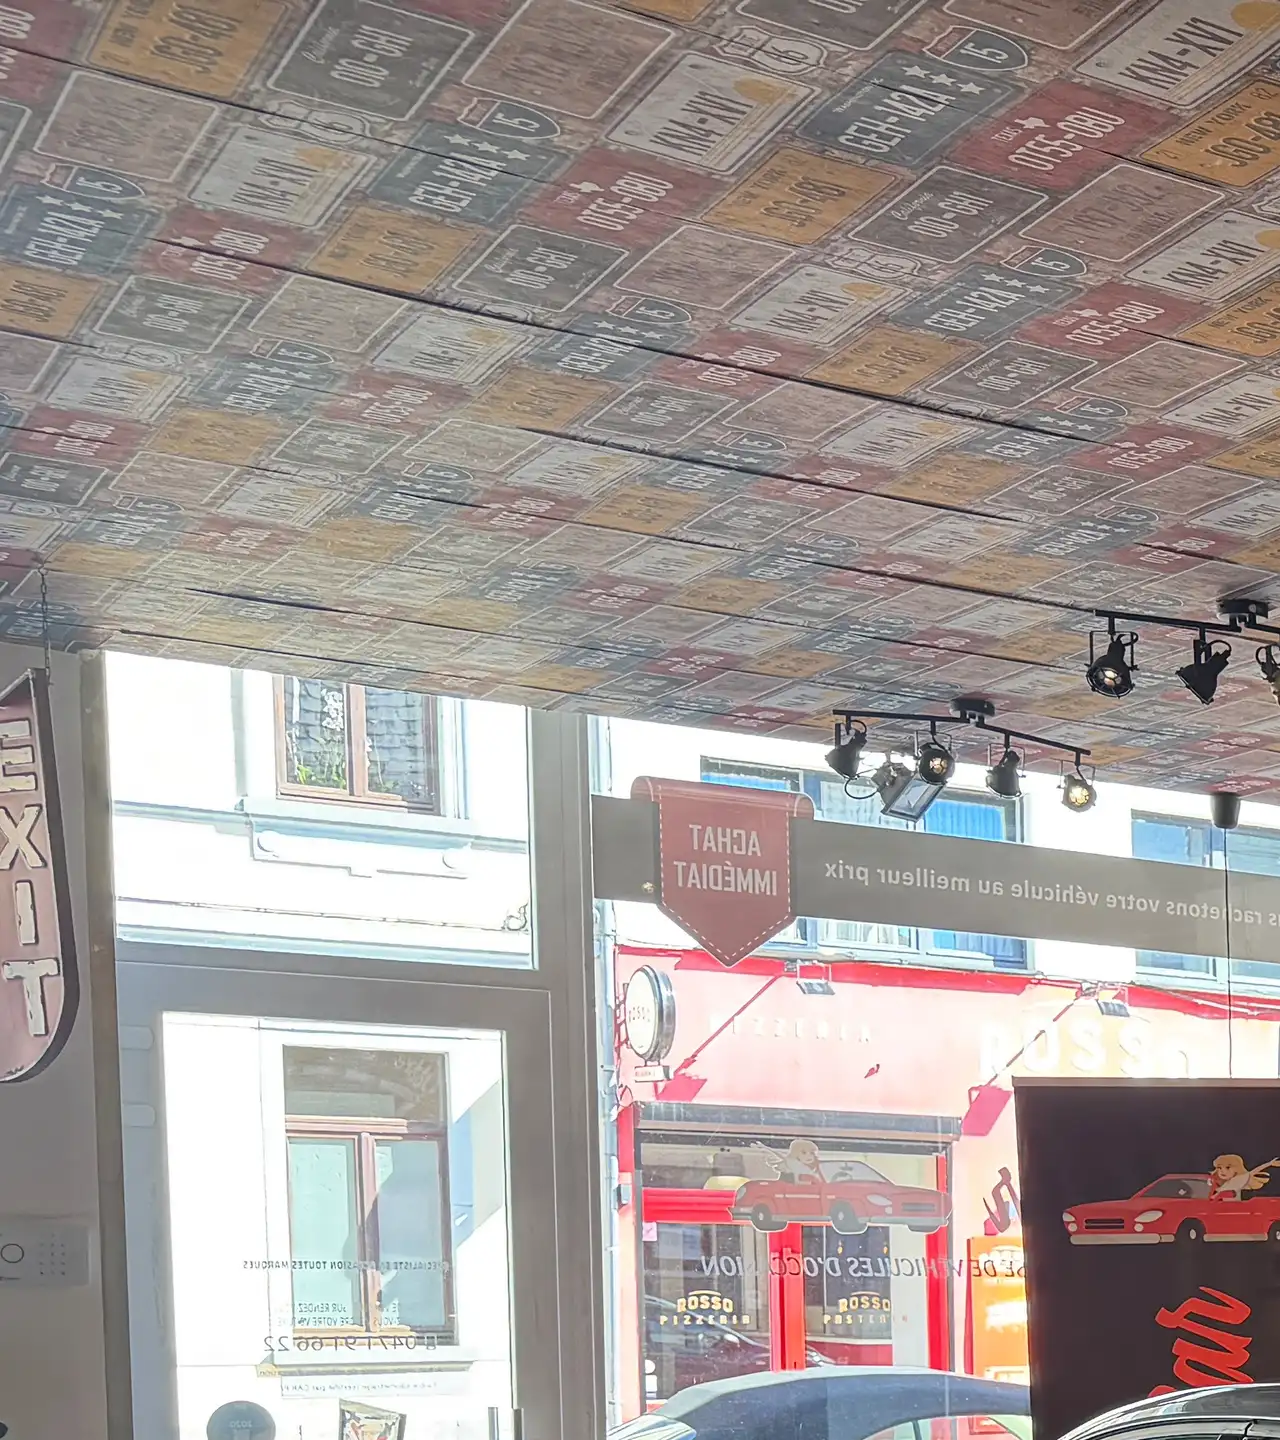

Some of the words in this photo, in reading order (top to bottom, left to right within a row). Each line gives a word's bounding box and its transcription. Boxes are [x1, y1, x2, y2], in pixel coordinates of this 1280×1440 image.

[0, 718, 60, 1037] EXIT
[677, 1295, 734, 1313] ROSSO
[838, 1295, 891, 1313] ROSSO
[1148, 1286, 1254, 1398] ar
